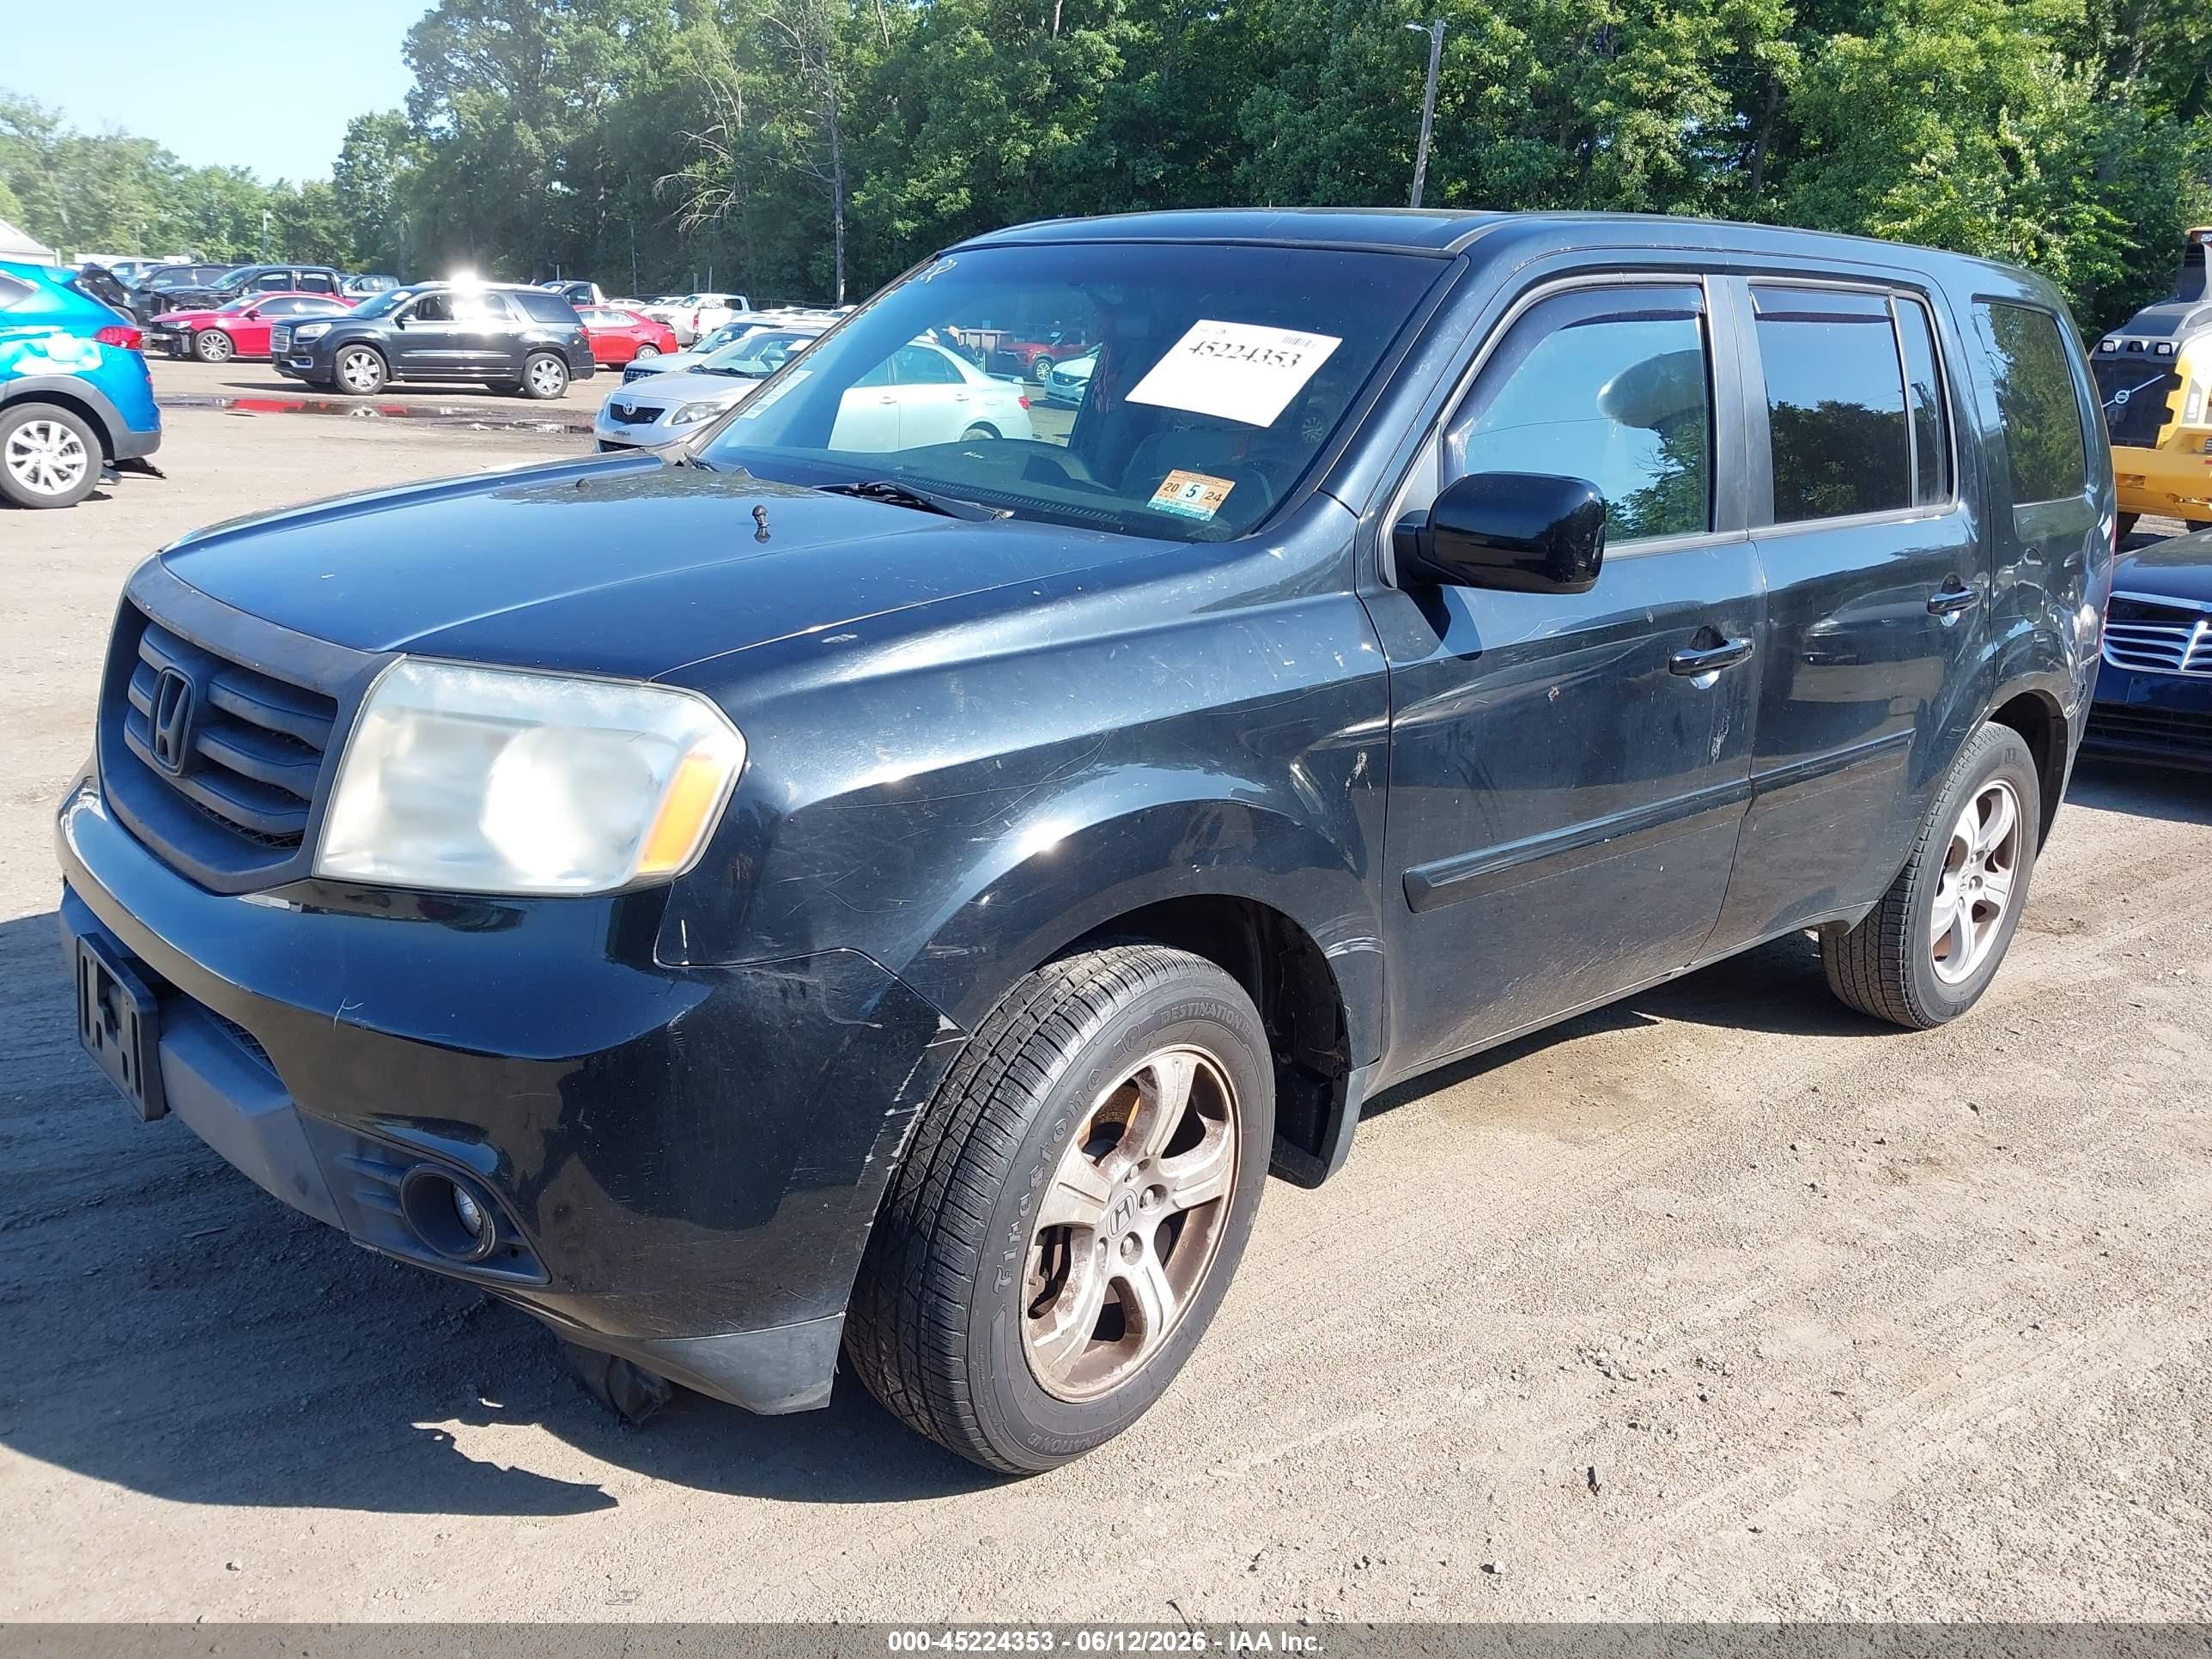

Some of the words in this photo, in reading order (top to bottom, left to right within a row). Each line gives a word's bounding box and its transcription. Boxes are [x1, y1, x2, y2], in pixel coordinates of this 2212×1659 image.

[1188, 341, 1302, 368] 45224353
[1163, 482, 1180, 493] 20
[1186, 483, 1200, 498] 5
[1204, 491, 1223, 502] 24
[1160, 1001, 1242, 1027] DESTINATION
